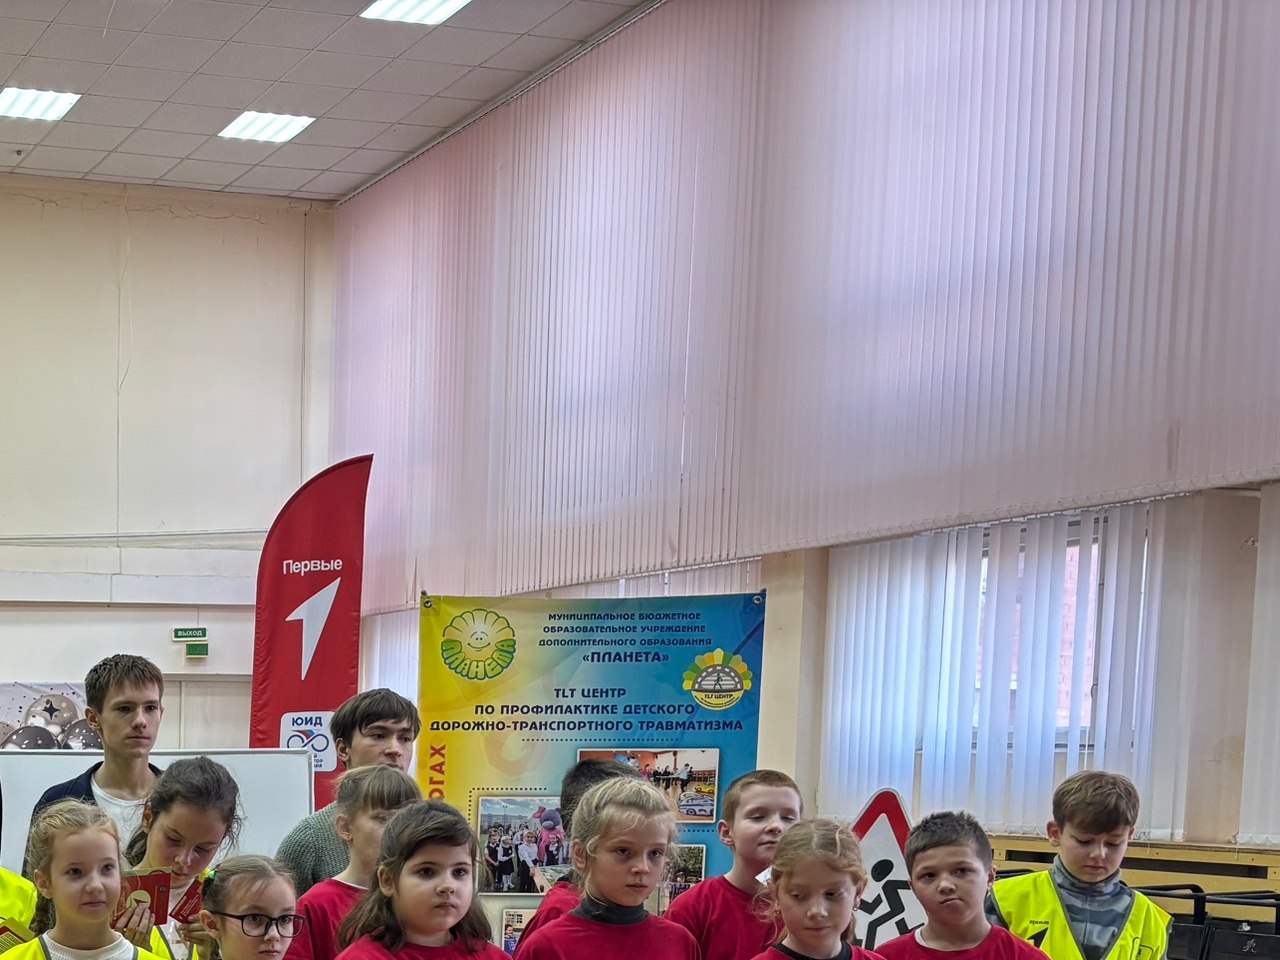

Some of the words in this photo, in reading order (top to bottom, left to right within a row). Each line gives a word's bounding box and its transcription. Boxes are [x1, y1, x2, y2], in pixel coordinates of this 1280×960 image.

[283, 558, 343, 576] Первые
[548, 613, 635, 621] МУНИЦИПАЛЬНОЕ
[638, 612, 701, 620] БЮДЖЕТНОЕ
[538, 638, 636, 647] ДОПОЛНИТЕЛЬНОГО
[639, 638, 712, 646] ОБРАЗОВАНИЯ
[582, 652, 670, 663] «ПЛАНЕТА»
[554, 688, 576, 698] TLT
[581, 688, 627, 699] ЦЕНТР
[474, 704, 495, 714] ПО
[500, 704, 618, 715] ПРОФИЛАКТИКЕ
[622, 704, 695, 716] ДЕТСКОГО
[292, 716, 322, 727] ЮИД
[430, 720, 634, 732] ДОРОЖНО-ТРАНСПОРТНОГО
[638, 720, 743, 732] ТРАВМАТИЗМА
[428, 744, 446, 800] ОГАХ
